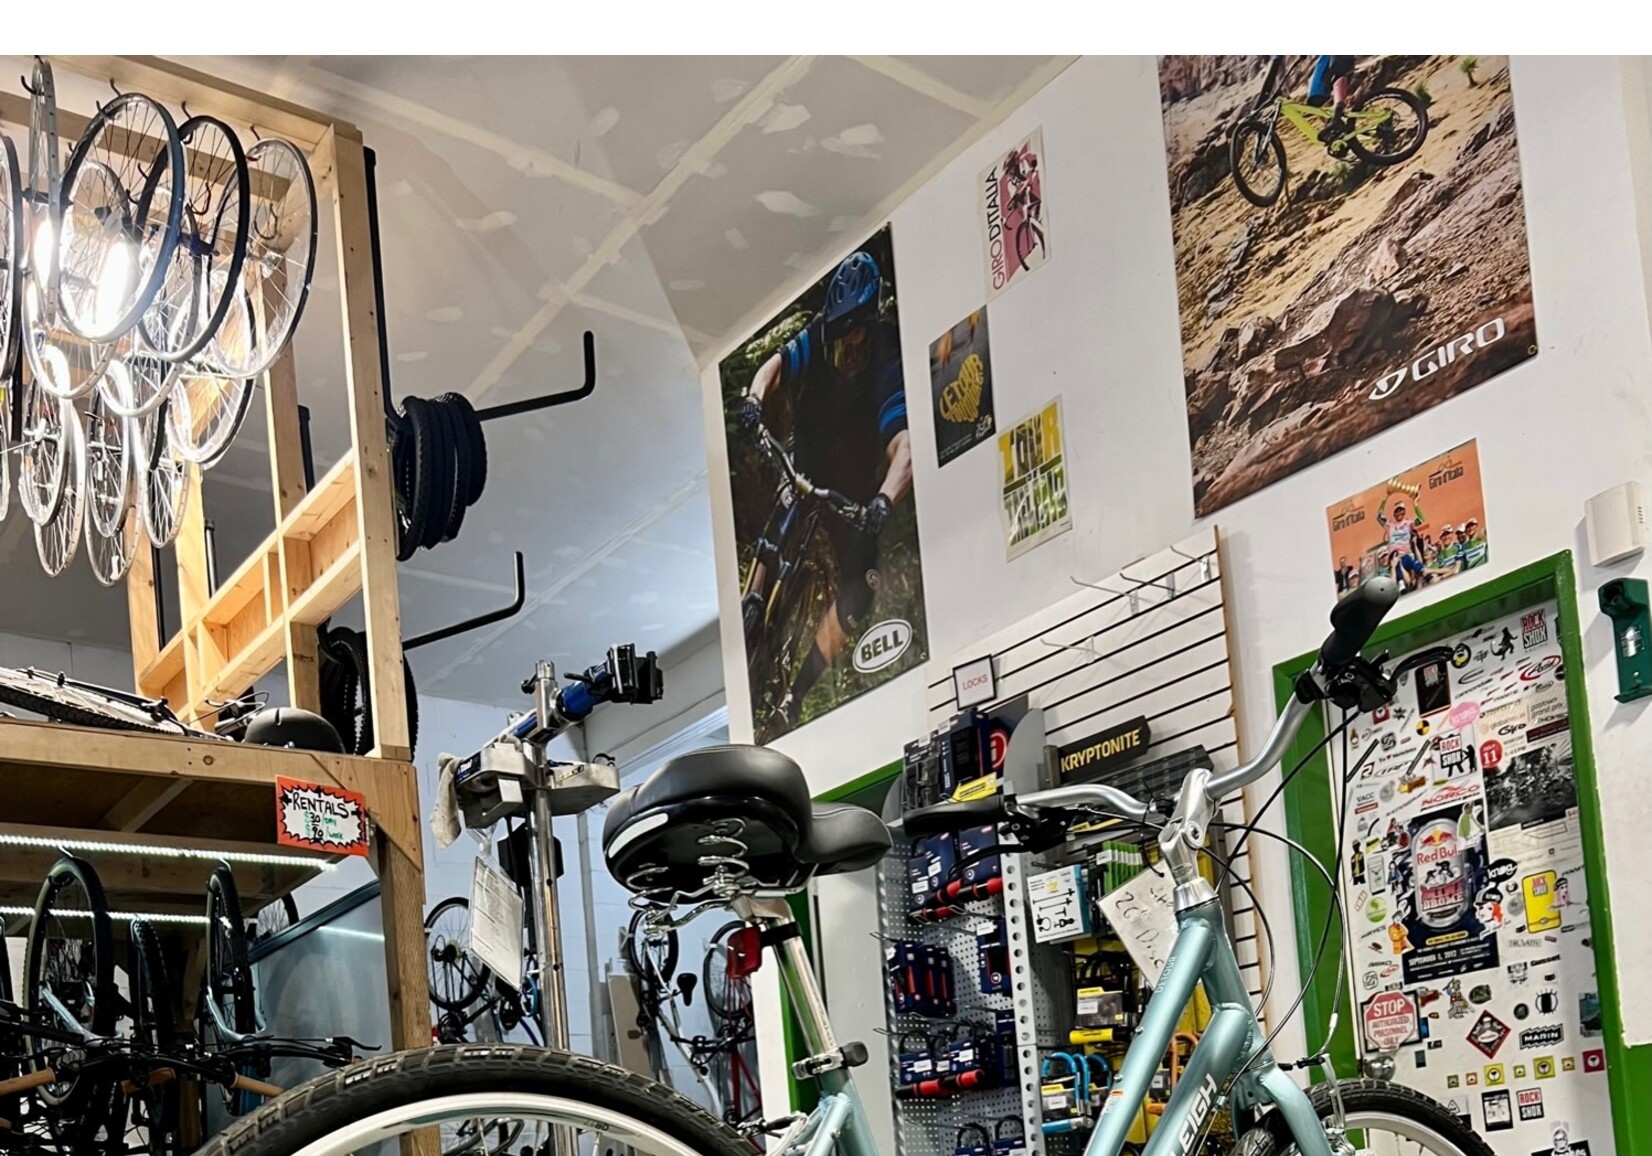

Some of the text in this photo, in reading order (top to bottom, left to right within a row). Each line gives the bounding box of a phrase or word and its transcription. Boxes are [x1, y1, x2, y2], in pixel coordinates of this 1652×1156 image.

[1412, 317, 1505, 382] GIRO
[1521, 609, 1545, 631] ROCK
[1524, 627, 1547, 648] SHOX
[860, 630, 904, 664] BELL
[962, 674, 988, 690] LOCKS
[1061, 729, 1140, 773] KRYPTONITE
[1441, 741, 1460, 752] ROCK
[1483, 751, 1498, 765] 11
[1421, 785, 1480, 806] NORCO
[292, 792, 349, 819] RENTALS
[1416, 844, 1461, 865] Red Bul
[1487, 863, 1518, 879] knog
[1373, 999, 1406, 1018] STOP
[1372, 1016, 1410, 1030] AUTHORIZED
[1373, 1026, 1408, 1038] PERSONNEL
[1525, 1031, 1558, 1041] MARIN
[1519, 1091, 1540, 1104] ROCK
[1521, 1105, 1543, 1119] SHOX
